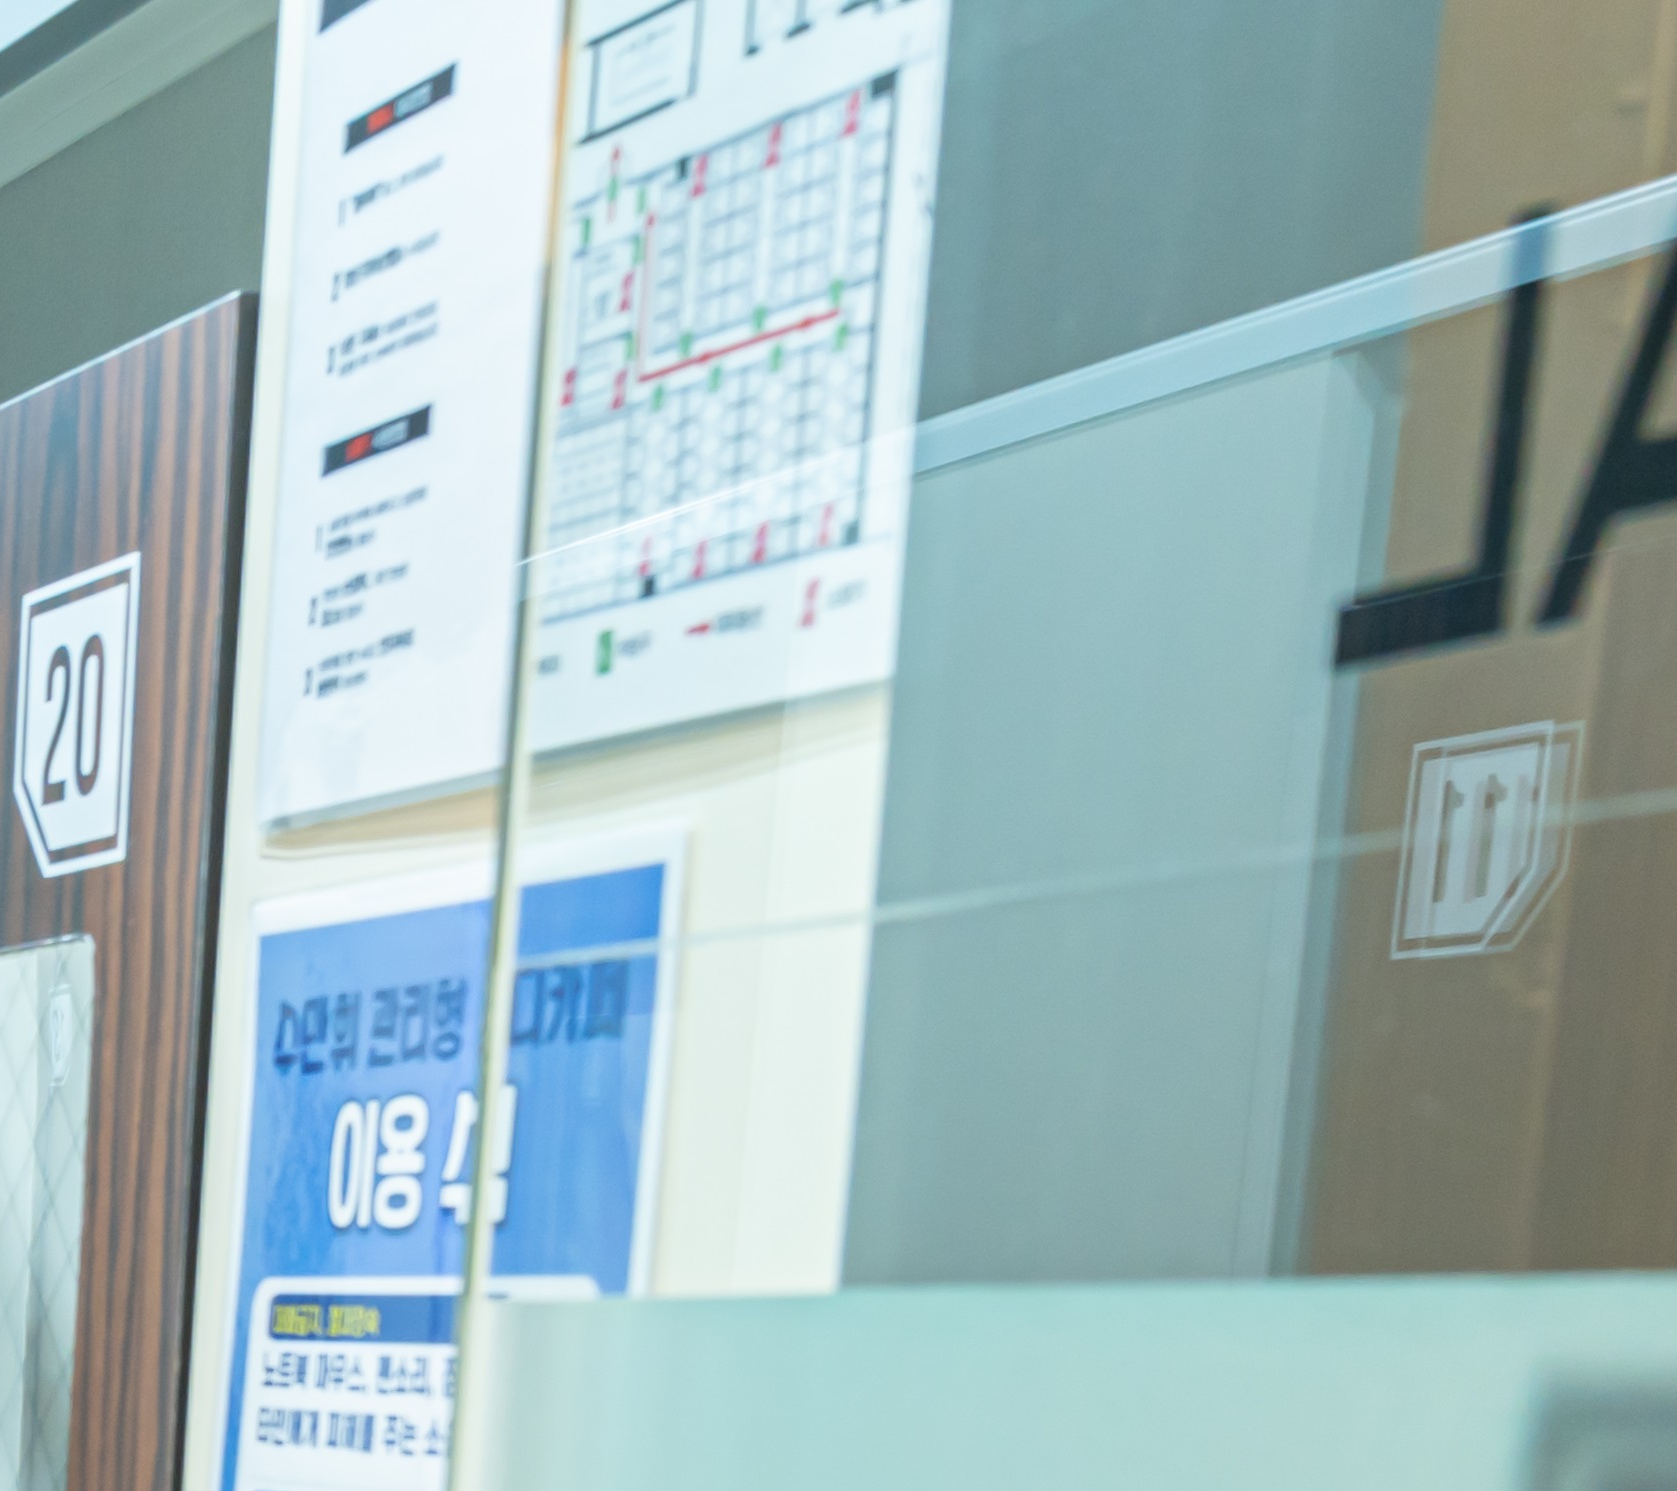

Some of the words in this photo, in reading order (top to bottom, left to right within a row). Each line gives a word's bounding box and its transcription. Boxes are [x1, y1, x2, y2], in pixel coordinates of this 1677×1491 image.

[41, 631, 105, 807] 20
[327, 1093, 430, 1230] 이용
[385, 1415, 417, 1456] 주는
